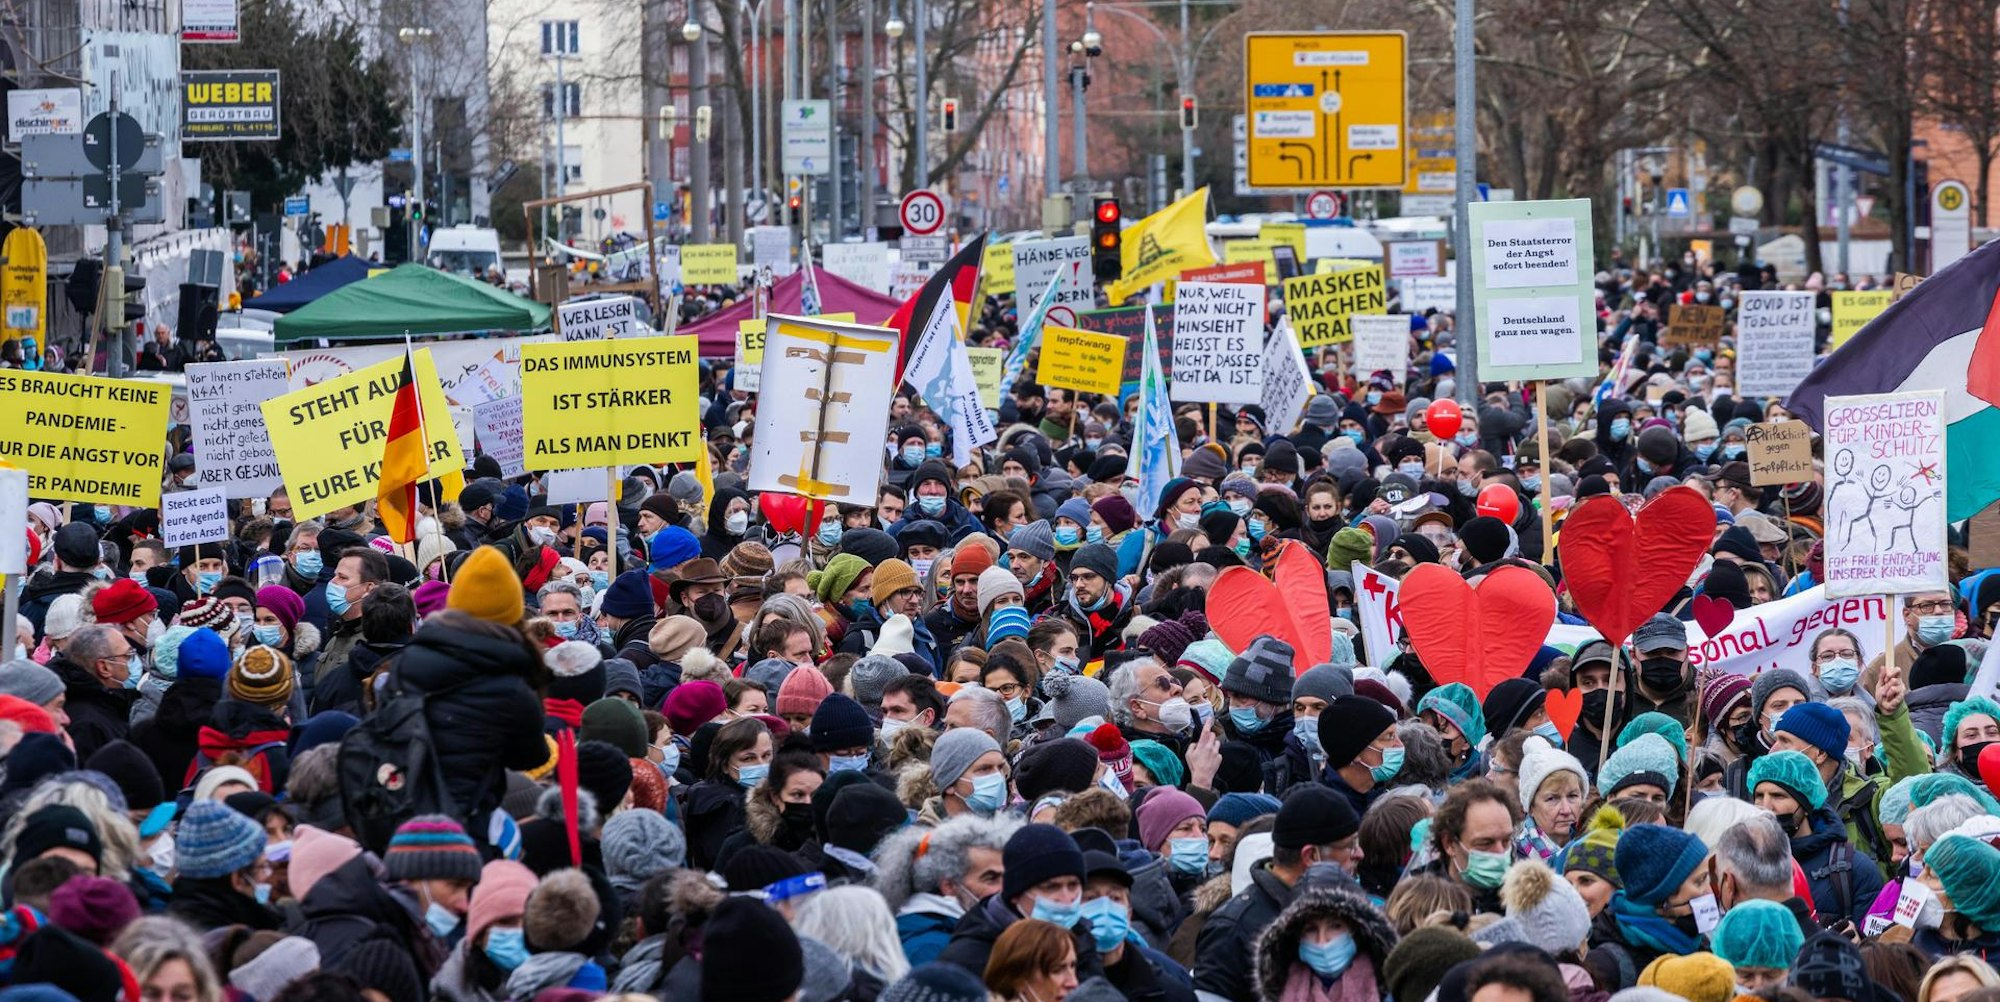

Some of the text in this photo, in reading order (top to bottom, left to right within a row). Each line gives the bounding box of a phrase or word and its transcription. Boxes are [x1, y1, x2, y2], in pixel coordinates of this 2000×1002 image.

[187, 82, 273, 105] WEBER
[15, 116, 69, 129] dischinger
[189, 107, 273, 120] GERÜSTBAU
[187, 124, 225, 133] FREIBURG
[909, 203, 936, 224] 30
[1314, 201, 1332, 214] 30
[1487, 236, 1573, 248] Den Staatsterror
[1016, 245, 1090, 267] HÄNDE WEG
[1506, 249, 1555, 260] der Angst
[1492, 258, 1569, 271] sofort beenden!
[1289, 269, 1381, 301] MASKEN
[1028, 288, 1090, 308] KDERN
[1178, 287, 1246, 302] NUR, WEIL
[1842, 297, 1856, 306] ES
[1177, 302, 1257, 317] MAN NICHT
[1290, 291, 1384, 322] MACHEN
[1743, 296, 1812, 312] COVID IST
[562, 303, 632, 327] WER LESEN
[1104, 312, 1146, 331] gehorch
[1502, 315, 1565, 325] Deutschland
[1176, 319, 1247, 334] HINSIEHT
[1494, 327, 1576, 339] ganz neu wagen.
[744, 332, 766, 350] ES
[1056, 334, 1111, 352] Impfzwang
[1174, 337, 1246, 352] HEISST ES
[524, 349, 693, 373] DAS IMMUNSYSTEM
[908, 330, 937, 378] Freiheit ist
[1174, 354, 1214, 369] NICHT,
[190, 373, 207, 385] Vor
[210, 370, 242, 383] Ihnen
[1171, 368, 1222, 384] NICHT DA
[0, 376, 160, 405] ES BRAUCHT KEINE
[288, 384, 361, 427] STEHT
[367, 372, 403, 401] AU
[552, 387, 673, 411] IST STÄRKER
[201, 399, 264, 417] nicht geim
[967, 389, 990, 435] Freiheit
[1827, 400, 1938, 428] GROSSELTERN
[25, 410, 117, 433] PANDEMIE
[203, 418, 266, 432] nicht genes
[204, 429, 270, 448] nicht getest
[338, 418, 388, 452] FÜR
[498, 427, 524, 440] ZWAN
[1828, 422, 1934, 446] FÜR KINDER-
[534, 437, 571, 456] ALS
[575, 434, 622, 454] MAN
[626, 430, 693, 451] DENKT
[1765, 443, 1791, 456] gegen
[1870, 434, 1939, 460] SCHUTZ
[0, 440, 161, 469] UR DIE ANGST VOR
[206, 447, 236, 462] nicht
[199, 467, 233, 484] ABER
[28, 474, 143, 499] ER PANDEMIE
[299, 468, 362, 506] EURE
[167, 493, 223, 511] Steckt euch
[166, 510, 226, 528] eure Agenda
[167, 525, 226, 543] in den Arsch
[1851, 553, 1880, 567] FREIE
[1881, 550, 1942, 567] ENTFALTUNG
[1828, 564, 1928, 582] UNSERER KINDER
[1384, 589, 1404, 646] K
[1687, 597, 1887, 666] sonal gegen
